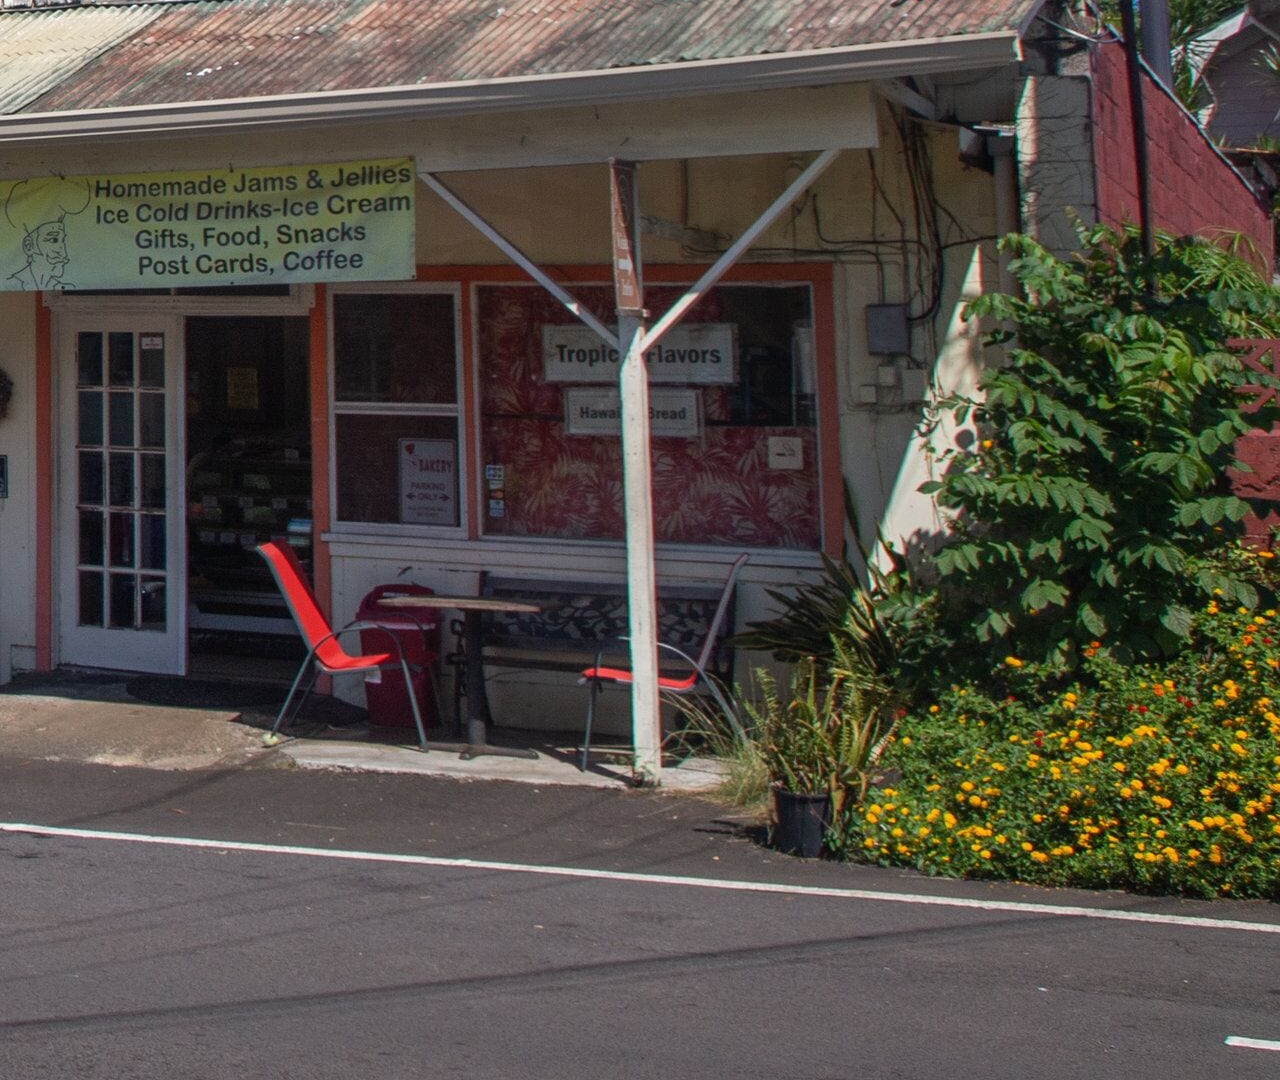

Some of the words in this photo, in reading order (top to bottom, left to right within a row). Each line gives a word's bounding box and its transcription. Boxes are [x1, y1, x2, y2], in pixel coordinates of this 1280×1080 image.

[94, 177, 226, 198] Homemade
[233, 173, 298, 193] Jams
[307, 170, 324, 189] &
[331, 165, 411, 187] Jellies
[96, 206, 129, 225] Ice
[136, 203, 188, 223] Cold
[196, 198, 319, 221] Drinks-Ice
[327, 194, 411, 214] Cream
[135, 229, 195, 251] Gifts,
[202, 226, 270, 248] Food,
[277, 222, 366, 245] Snacks
[138, 255, 190, 276] Post
[195, 253, 275, 275] Cards,
[283, 250, 364, 270] Coffee
[555, 344, 620, 367] Tropic
[419, 459, 452, 473] BAKERY
